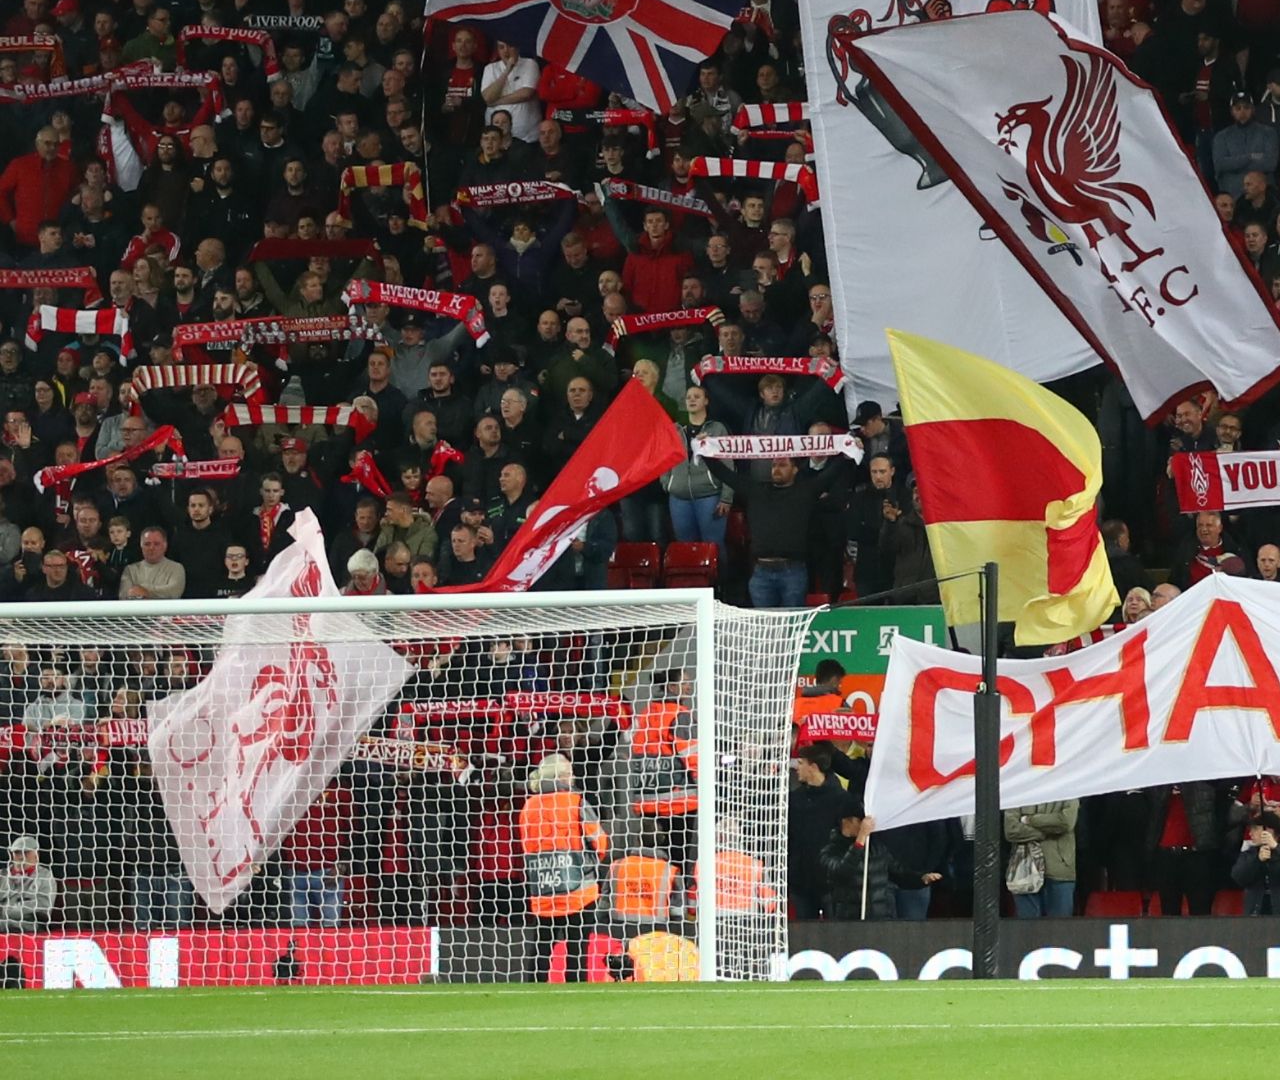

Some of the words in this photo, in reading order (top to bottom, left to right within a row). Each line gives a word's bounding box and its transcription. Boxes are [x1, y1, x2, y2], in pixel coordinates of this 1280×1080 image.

[248, 16, 320, 29] LIVERPOOL
[0, 35, 56, 48] RULES
[469, 184, 493, 196] WALK
[495, 183, 507, 192] ON
[0, 269, 88, 279] AMPIONS
[380, 282, 441, 305] LIVERPOOL
[449, 293, 467, 309] FC
[295, 317, 331, 325] LIVERPOOL
[635, 309, 692, 327] LIVERPOOL
[695, 308, 707, 319] FC
[299, 330, 331, 338] MADRID
[728, 356, 786, 367] LIVERPOOL
[799, 629, 858, 653] EXIT
[807, 714, 876, 731] LIVERPOOL
[833, 729, 852, 737] NEVER
